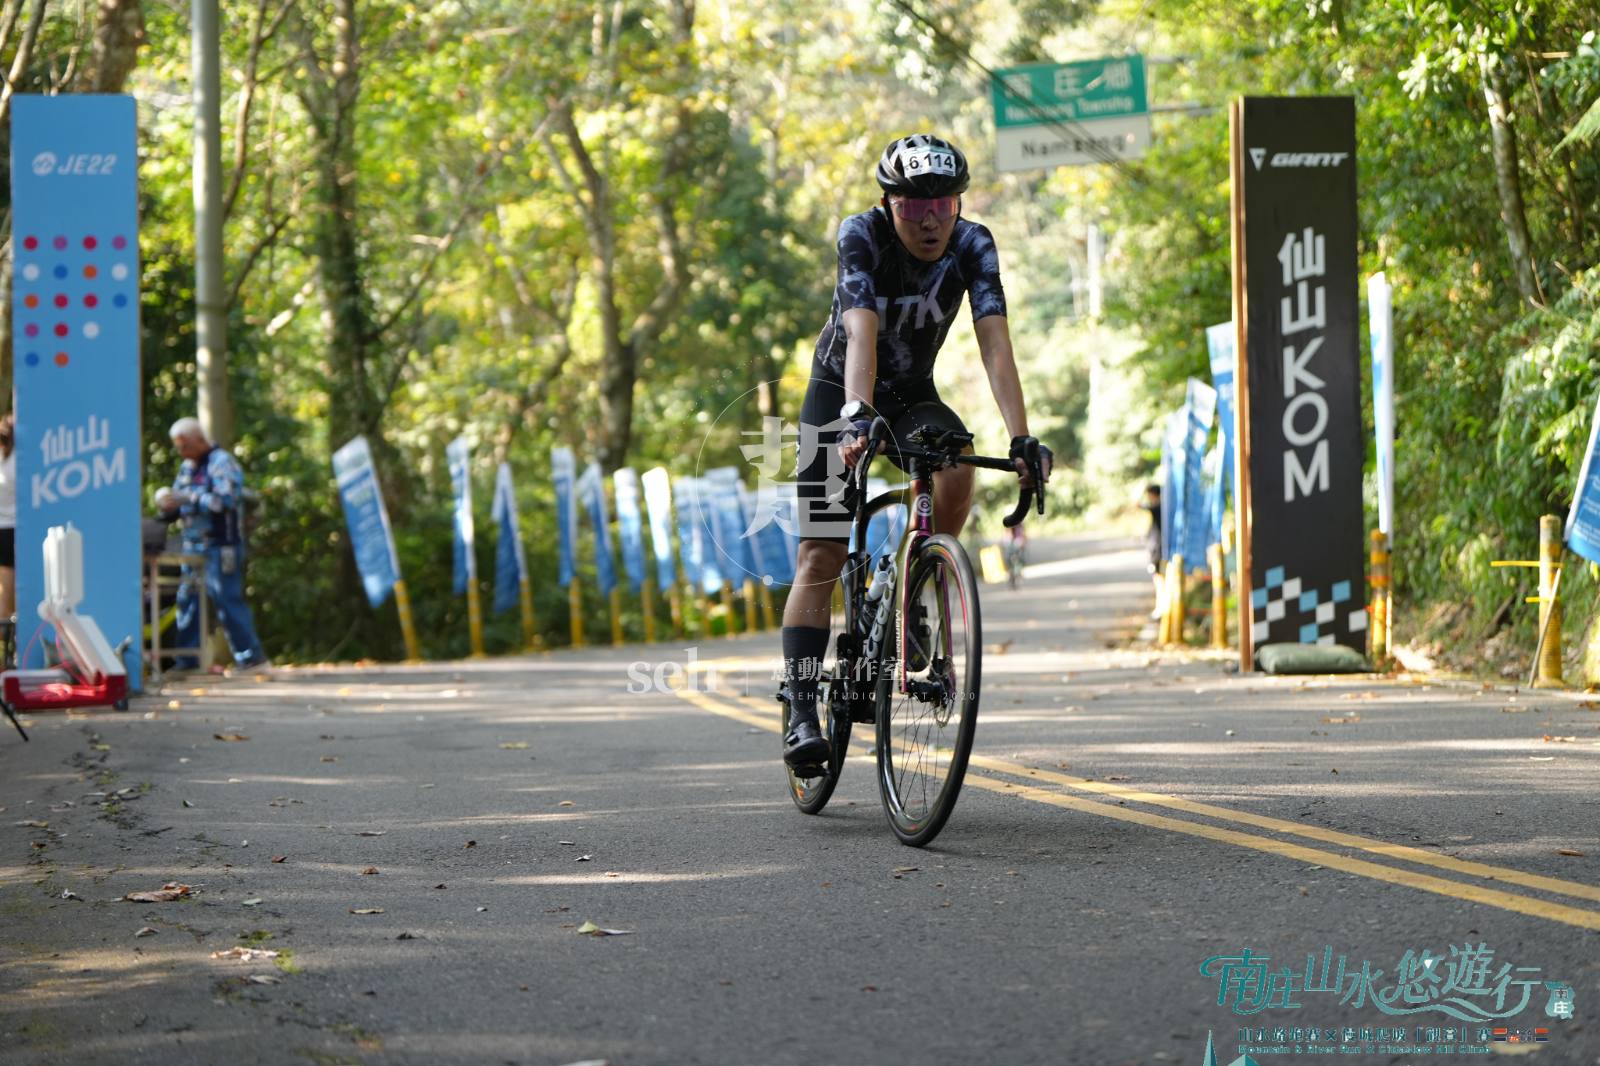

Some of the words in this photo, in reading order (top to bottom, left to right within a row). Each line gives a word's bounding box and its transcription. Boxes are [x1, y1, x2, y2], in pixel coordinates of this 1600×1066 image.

[57, 153, 117, 176] JE22
[1270, 152, 1349, 168] GIANT
[39, 413, 110, 468] 仙山
[31, 447, 126, 510] KOM
